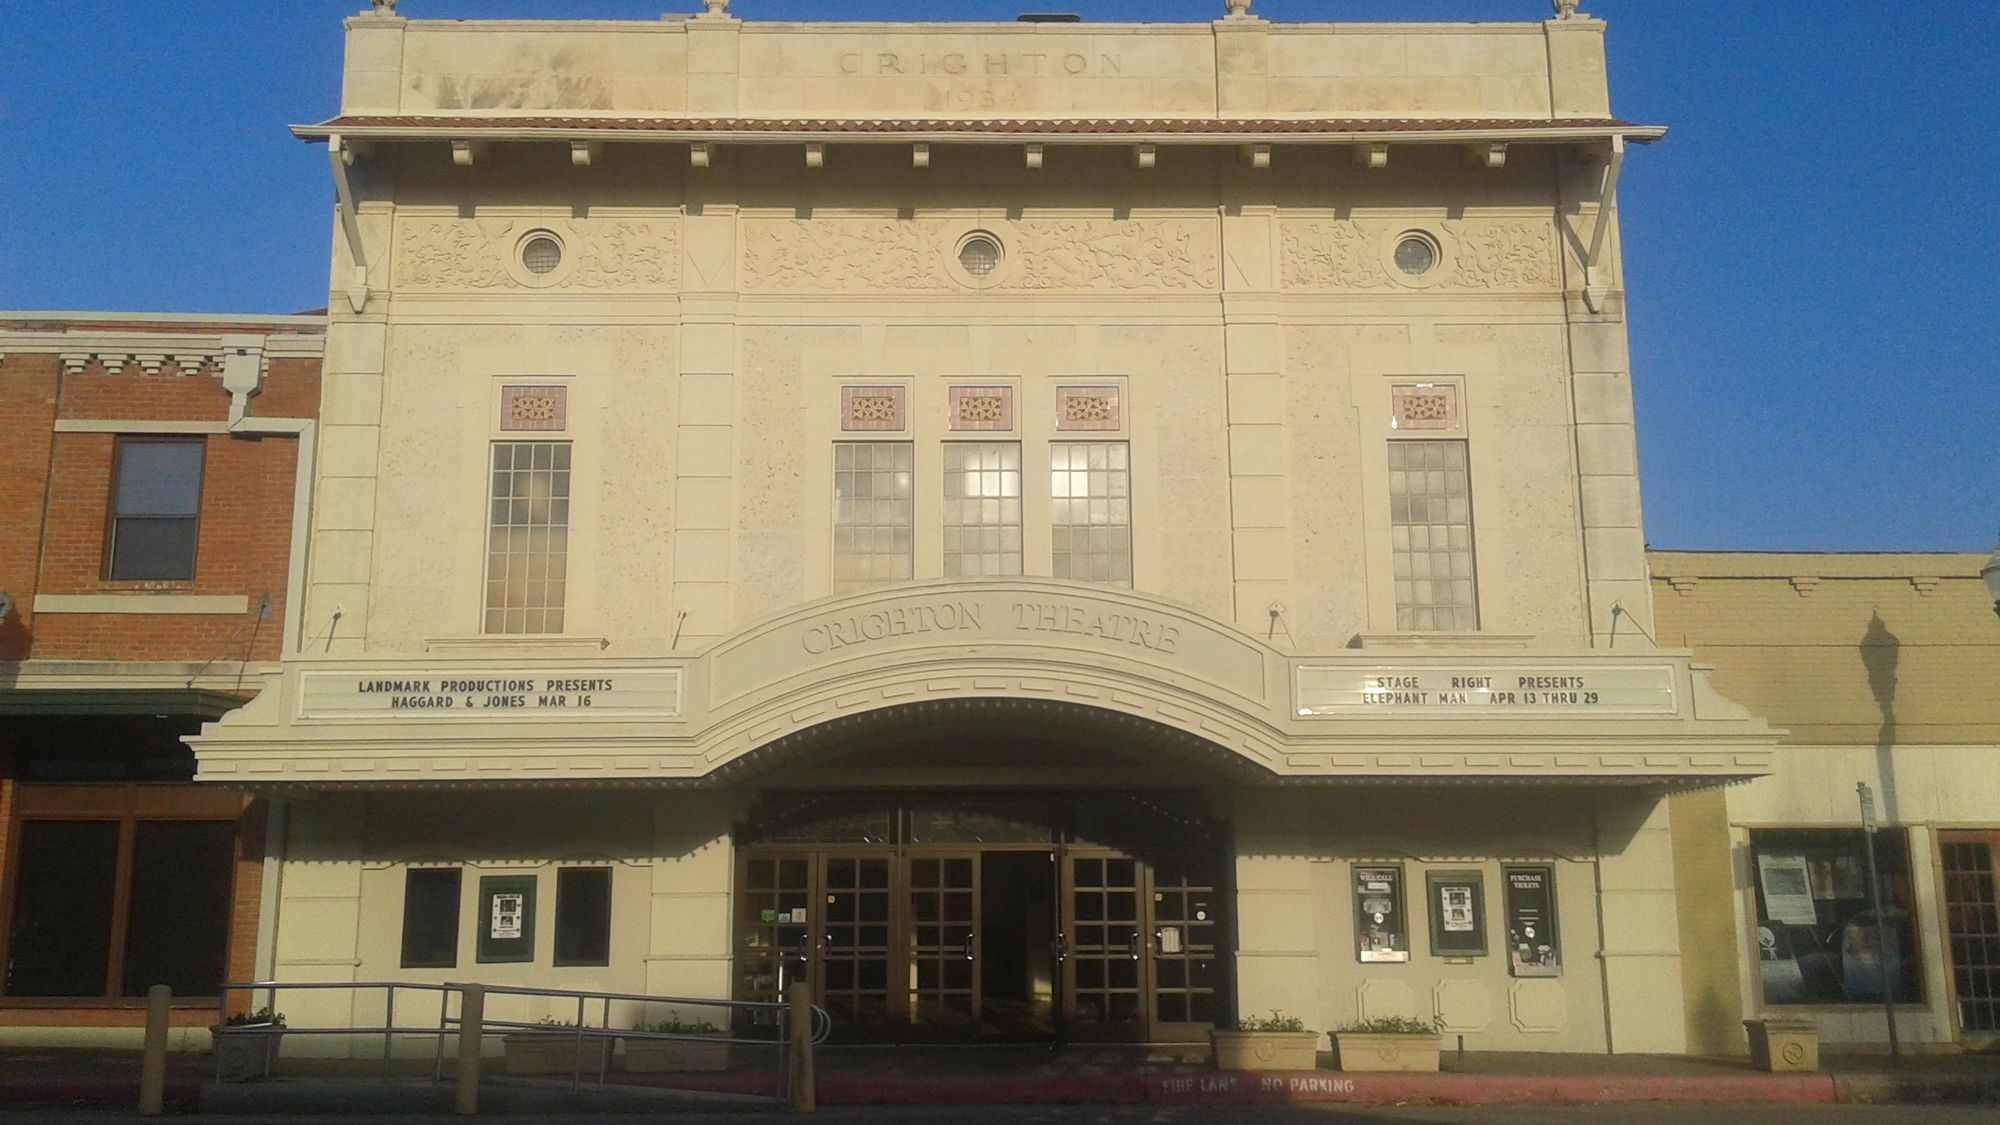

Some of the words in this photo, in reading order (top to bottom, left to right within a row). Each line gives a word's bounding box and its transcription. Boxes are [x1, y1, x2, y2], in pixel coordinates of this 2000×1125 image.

[838, 53, 1122, 76] CRIGHTON
[801, 602, 985, 655] CRIGHTON
[1012, 602, 1181, 655] THEATRE
[358, 680, 431, 693] LANDMARK
[440, 679, 535, 693] PRODUCTIONS
[546, 679, 613, 692] PRESENTS
[1377, 676, 1419, 688] STAGE
[1451, 676, 1493, 689] RIGHT
[1518, 676, 1585, 689] PRESENTS
[391, 695, 454, 709] HAGGARD
[465, 696, 474, 708] &
[483, 695, 526, 708] JONES
[538, 695, 566, 708] MAR
[577, 695, 592, 707] 16
[1362, 692, 1428, 705] ELEPHANT
[1439, 692, 1468, 704] MAN
[1489, 692, 1516, 704] APR
[1524, 692, 1537, 704] 13
[1542, 692, 1578, 704] THRU
[1583, 692, 1599, 704] 29
[1510, 874, 1542, 882] PURCHASE
[1162, 1078, 1193, 1095] FIRE
[1261, 1077, 1284, 1092] NO
[1290, 1078, 1355, 1093] PARKING
